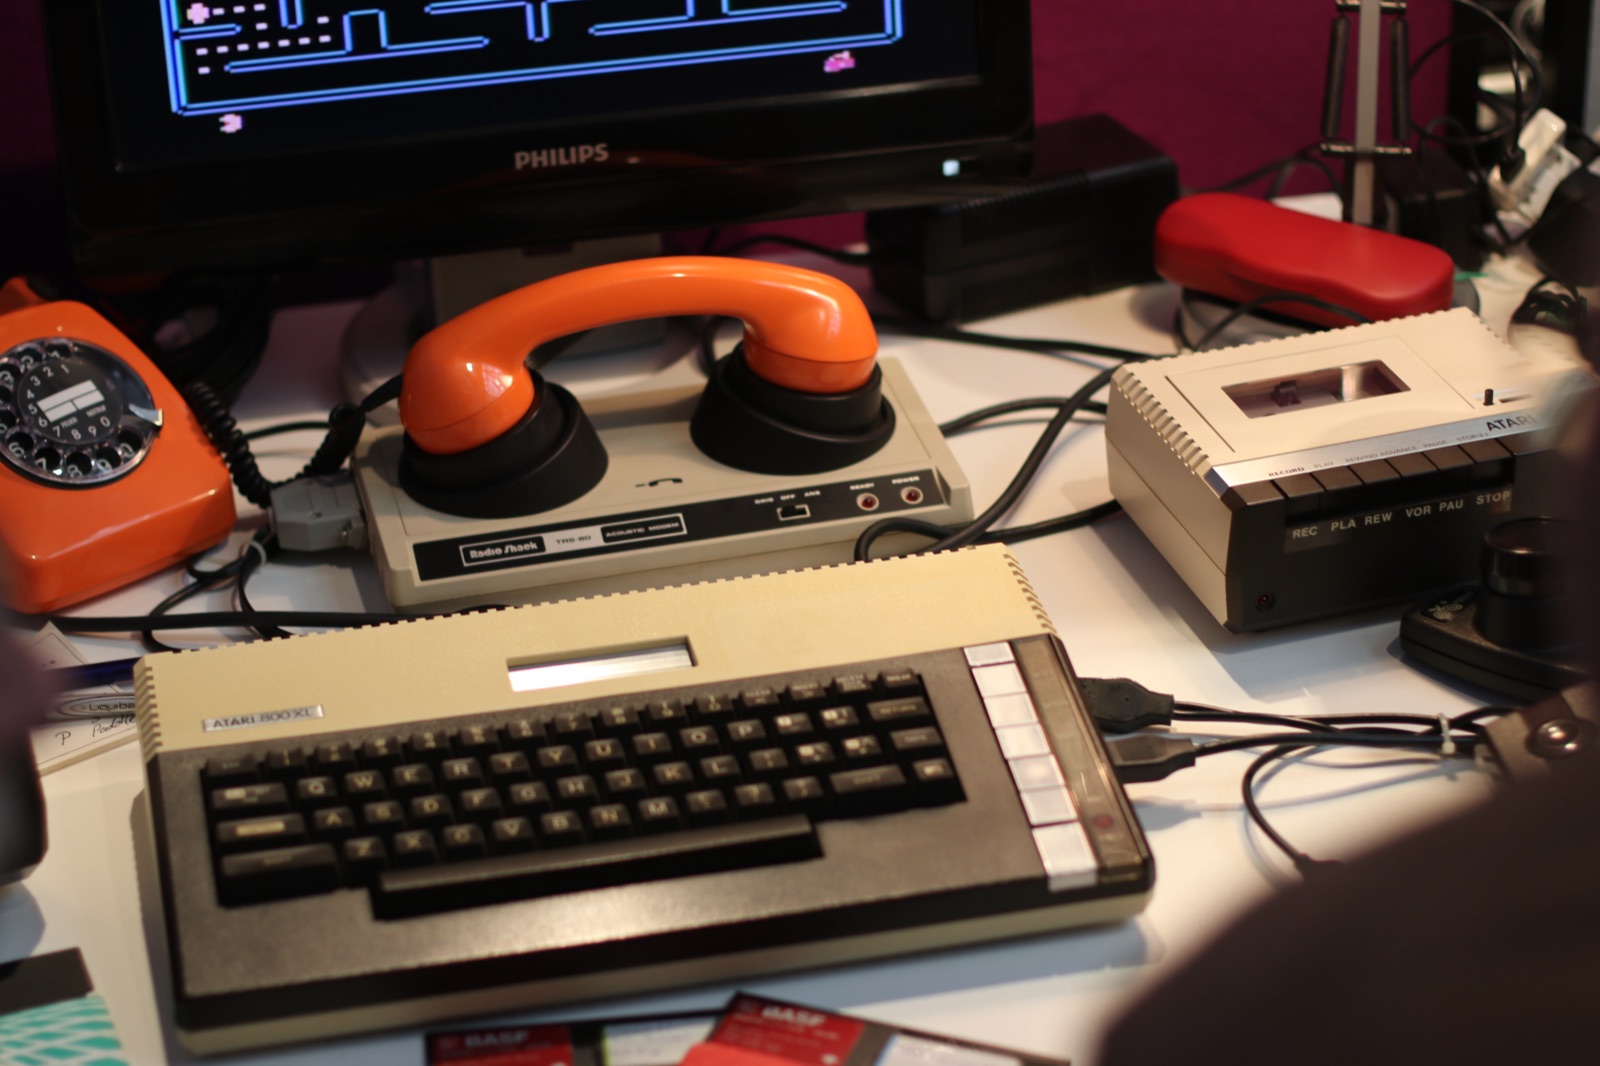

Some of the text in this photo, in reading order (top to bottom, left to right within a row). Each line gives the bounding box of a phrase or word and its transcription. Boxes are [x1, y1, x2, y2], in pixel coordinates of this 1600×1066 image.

[514, 143, 609, 170] PHILIPS
[43, 366, 54, 377] 2
[30, 376, 41, 386] 3
[27, 389, 35, 399] 4
[28, 403, 37, 414] 5
[38, 417, 48, 428] 6
[100, 416, 110, 427] 0
[1486, 414, 1537, 431] ATARI
[52, 425, 60, 437] 7
[71, 428, 81, 440] 8
[88, 425, 97, 437] 9
[1268, 466, 1305, 477] RECORD
[892, 476, 920, 484] POWER
[1292, 491, 1511, 539] REC PLA REW VOR PAU STOP
[605, 521, 680, 538] ACOUSTIC MODEM
[555, 535, 592, 545] TRS-80
[469, 541, 538, 559] Radio Shack
[213, 715, 255, 728] ATARI
[354, 775, 373, 787] W
[403, 768, 419, 782] E
[453, 762, 469, 775] R
[595, 742, 612, 756] U
[690, 731, 707, 743] O
[738, 724, 752, 737] P
[326, 812, 342, 826] A
[423, 799, 439, 813] D
[567, 780, 585, 793] H
[617, 773, 632, 786] J
[664, 767, 681, 780] K
[711, 760, 728, 773] L
[405, 834, 421, 848] X
[504, 822, 520, 836] V
[552, 816, 569, 830] B
[601, 809, 618, 823] N
[648, 801, 668, 815] M
[761, 1005, 826, 1027] BASF
[465, 1030, 529, 1048] BASF
